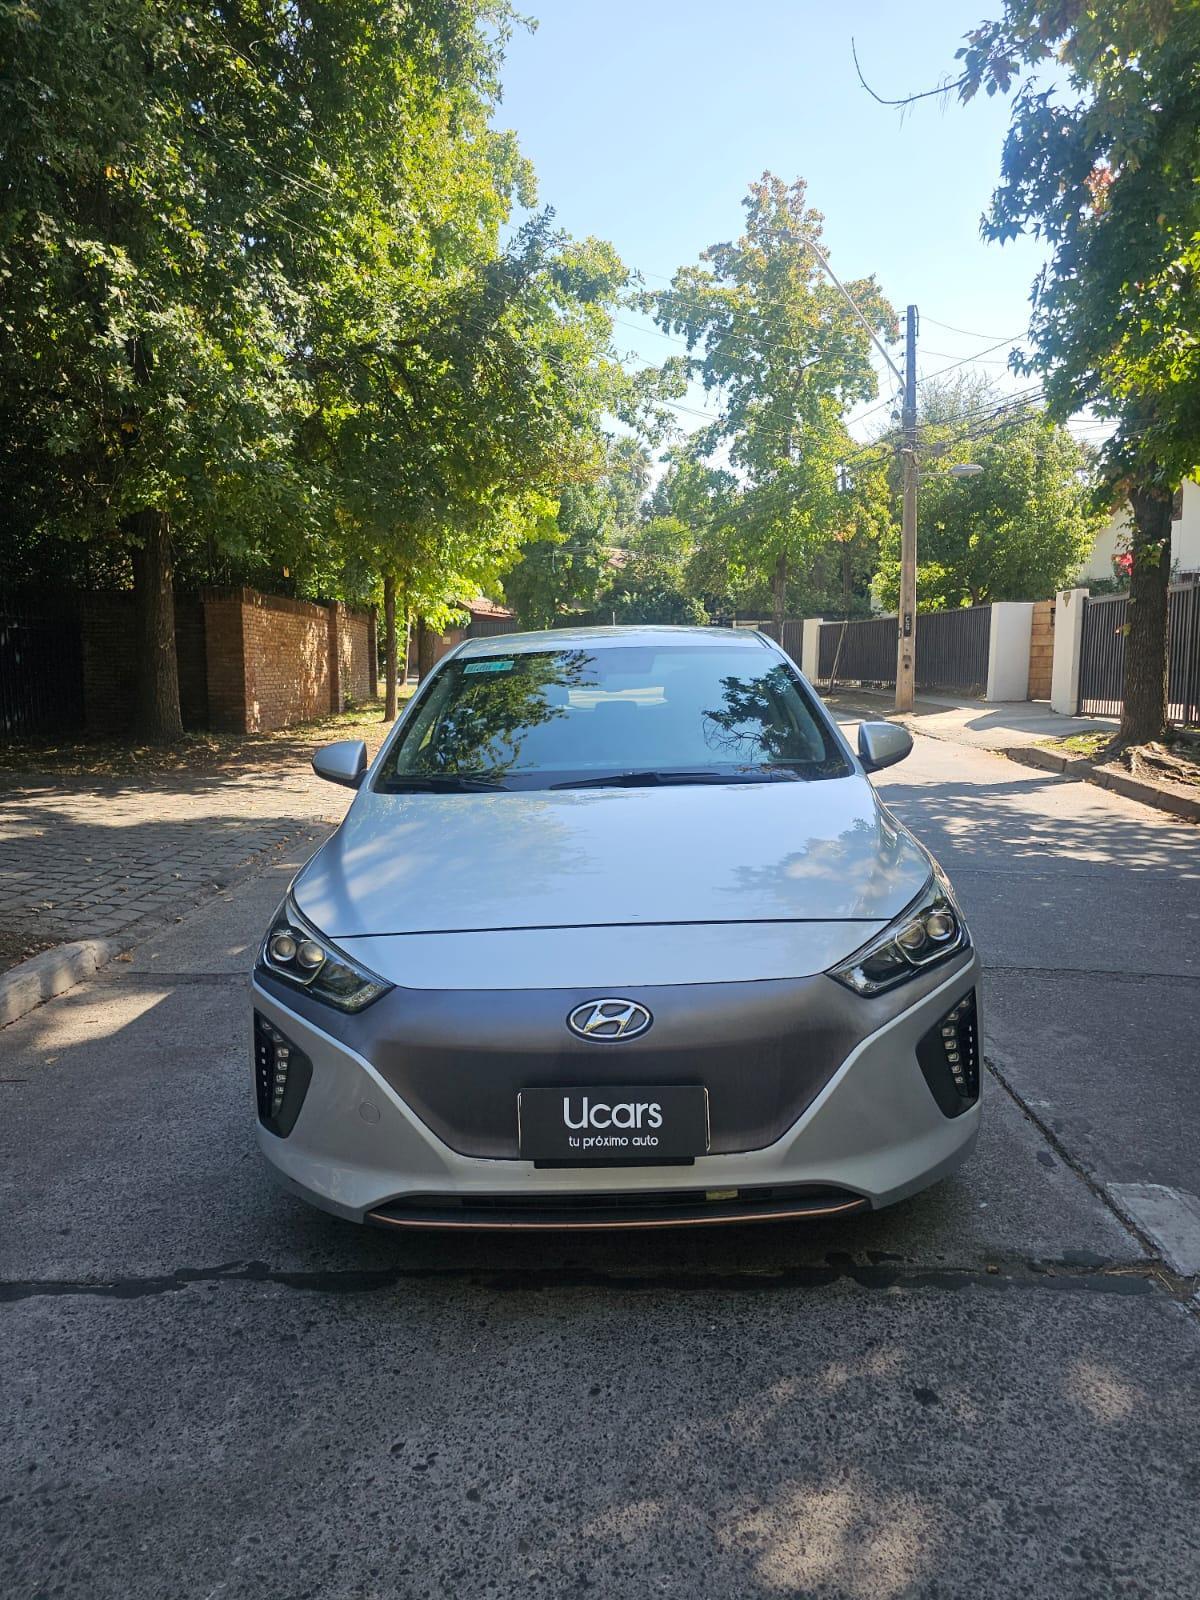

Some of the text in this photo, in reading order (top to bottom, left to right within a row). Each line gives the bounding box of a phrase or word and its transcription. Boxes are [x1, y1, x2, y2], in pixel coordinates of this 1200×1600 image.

[563, 1096, 663, 1129] Ucars
[568, 1134, 659, 1150] tu próximo auto
